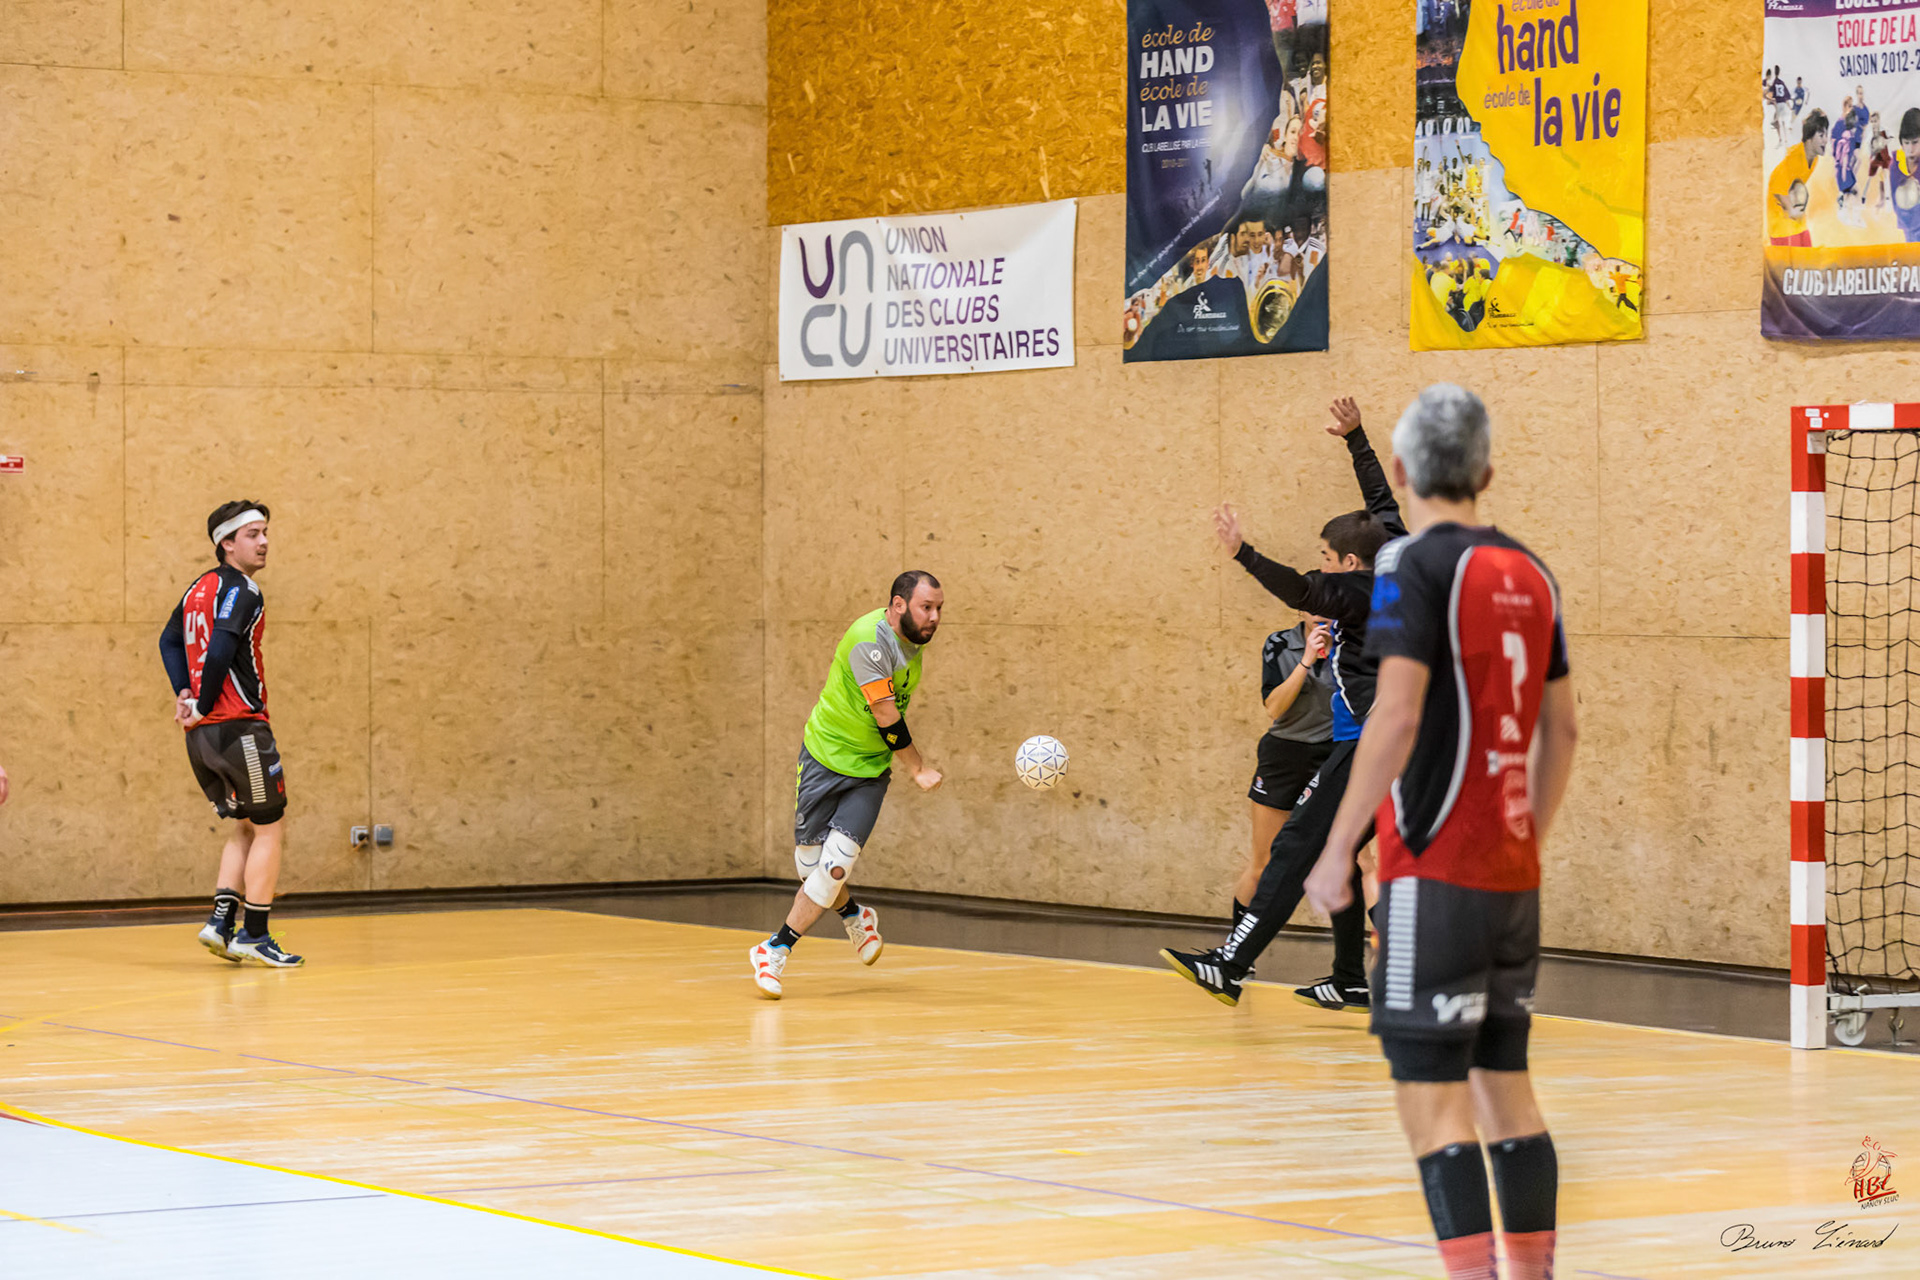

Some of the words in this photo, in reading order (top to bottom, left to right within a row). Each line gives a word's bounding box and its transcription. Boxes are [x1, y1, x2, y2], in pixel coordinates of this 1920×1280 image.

[1141, 24, 1186, 48] école
[1188, 22, 1215, 43] de
[1497, 0, 1579, 74] hand
[1837, 14, 1877, 48] ÉCOLE
[1880, 16, 1897, 45] DE
[1901, 14, 1917, 43] LA
[1140, 45, 1215, 79] HAND
[1840, 53, 1878, 77] SAISON
[1140, 78, 1183, 102] école
[1187, 75, 1209, 96] de
[1141, 105, 1172, 133] LA
[1175, 100, 1212, 129] VIE
[1484, 84, 1516, 109] école
[1518, 83, 1530, 105] de
[1534, 77, 1563, 147] la
[1571, 72, 1621, 141] vie
[885, 226, 948, 255] UNION
[887, 257, 1005, 292] NATIONALE
[1782, 268, 1824, 296] CLUB
[1826, 261, 1899, 296] LABELLISÉ
[886, 299, 925, 329] DES
[929, 294, 1000, 326] CLUBS
[884, 327, 1060, 366] UNIVERSITAIRES
